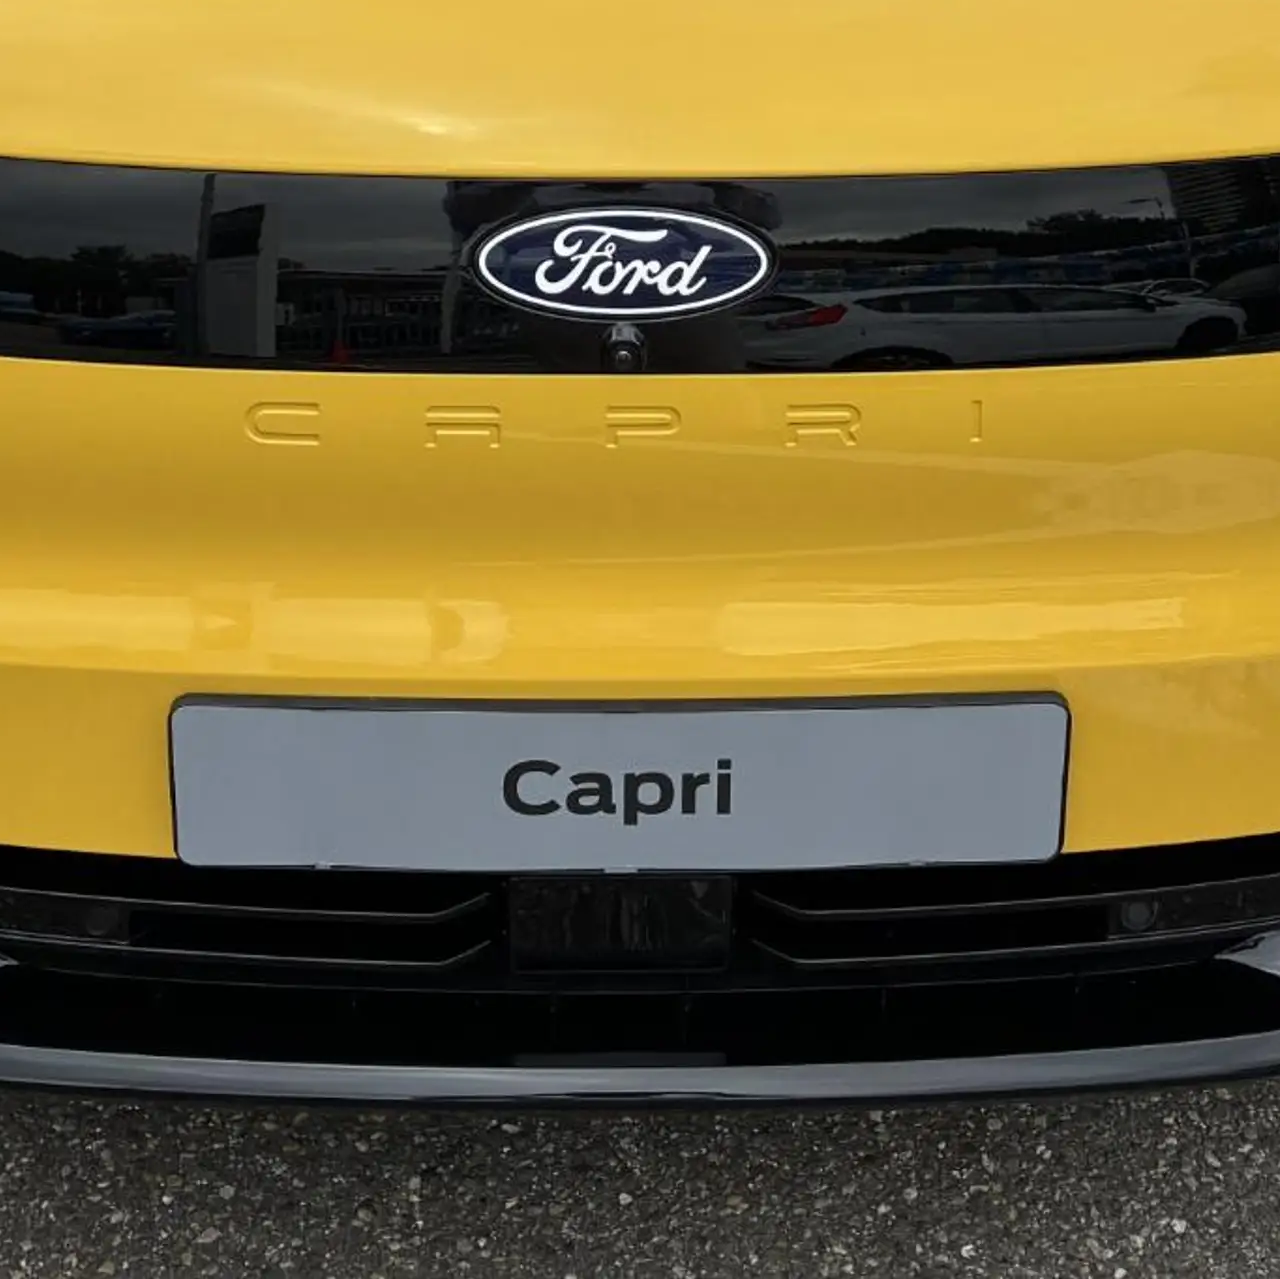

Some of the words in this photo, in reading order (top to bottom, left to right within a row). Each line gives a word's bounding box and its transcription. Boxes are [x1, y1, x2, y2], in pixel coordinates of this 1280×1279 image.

[533, 224, 712, 297] Ford
[244, 399, 985, 450] CAPRI
[502, 758, 733, 826] Capri
